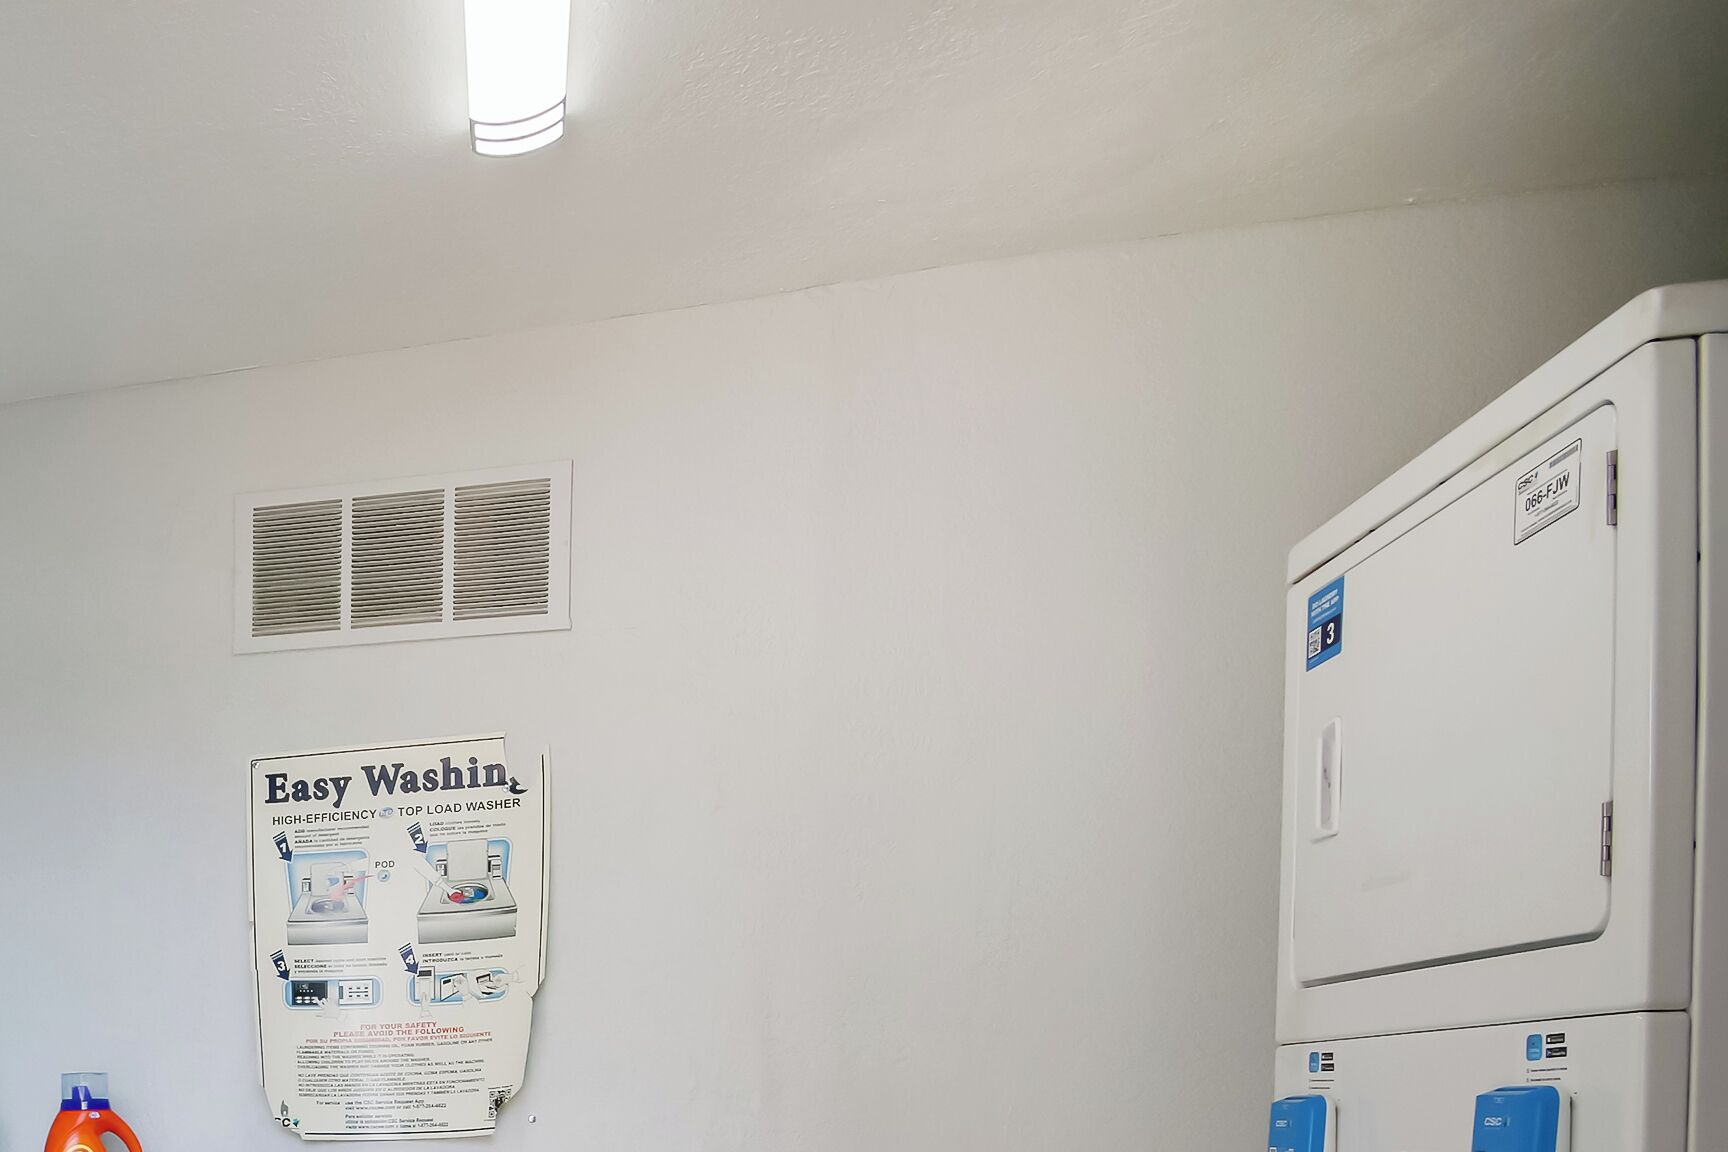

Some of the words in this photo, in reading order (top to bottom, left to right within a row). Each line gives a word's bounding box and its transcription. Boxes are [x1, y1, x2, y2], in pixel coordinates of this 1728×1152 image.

[1525, 471, 1569, 511] 066-FJW
[1326, 622, 1335, 645] 3
[265, 773, 352, 808] Easy
[272, 809, 377, 826] HIGH-EFFICIENCY
[398, 806, 423, 818] TOP
[427, 802, 462, 815] LOAD
[466, 798, 521, 813] WASHER
[414, 833, 424, 844] 2
[279, 842, 288, 853] 1
[375, 860, 395, 868] POD
[406, 954, 415, 965] 4
[277, 960, 286, 971] 3
[405, 1021, 437, 1029] SAFETY
[333, 1030, 366, 1038] PLEASE
[415, 1026, 465, 1035] FOLLOWING
